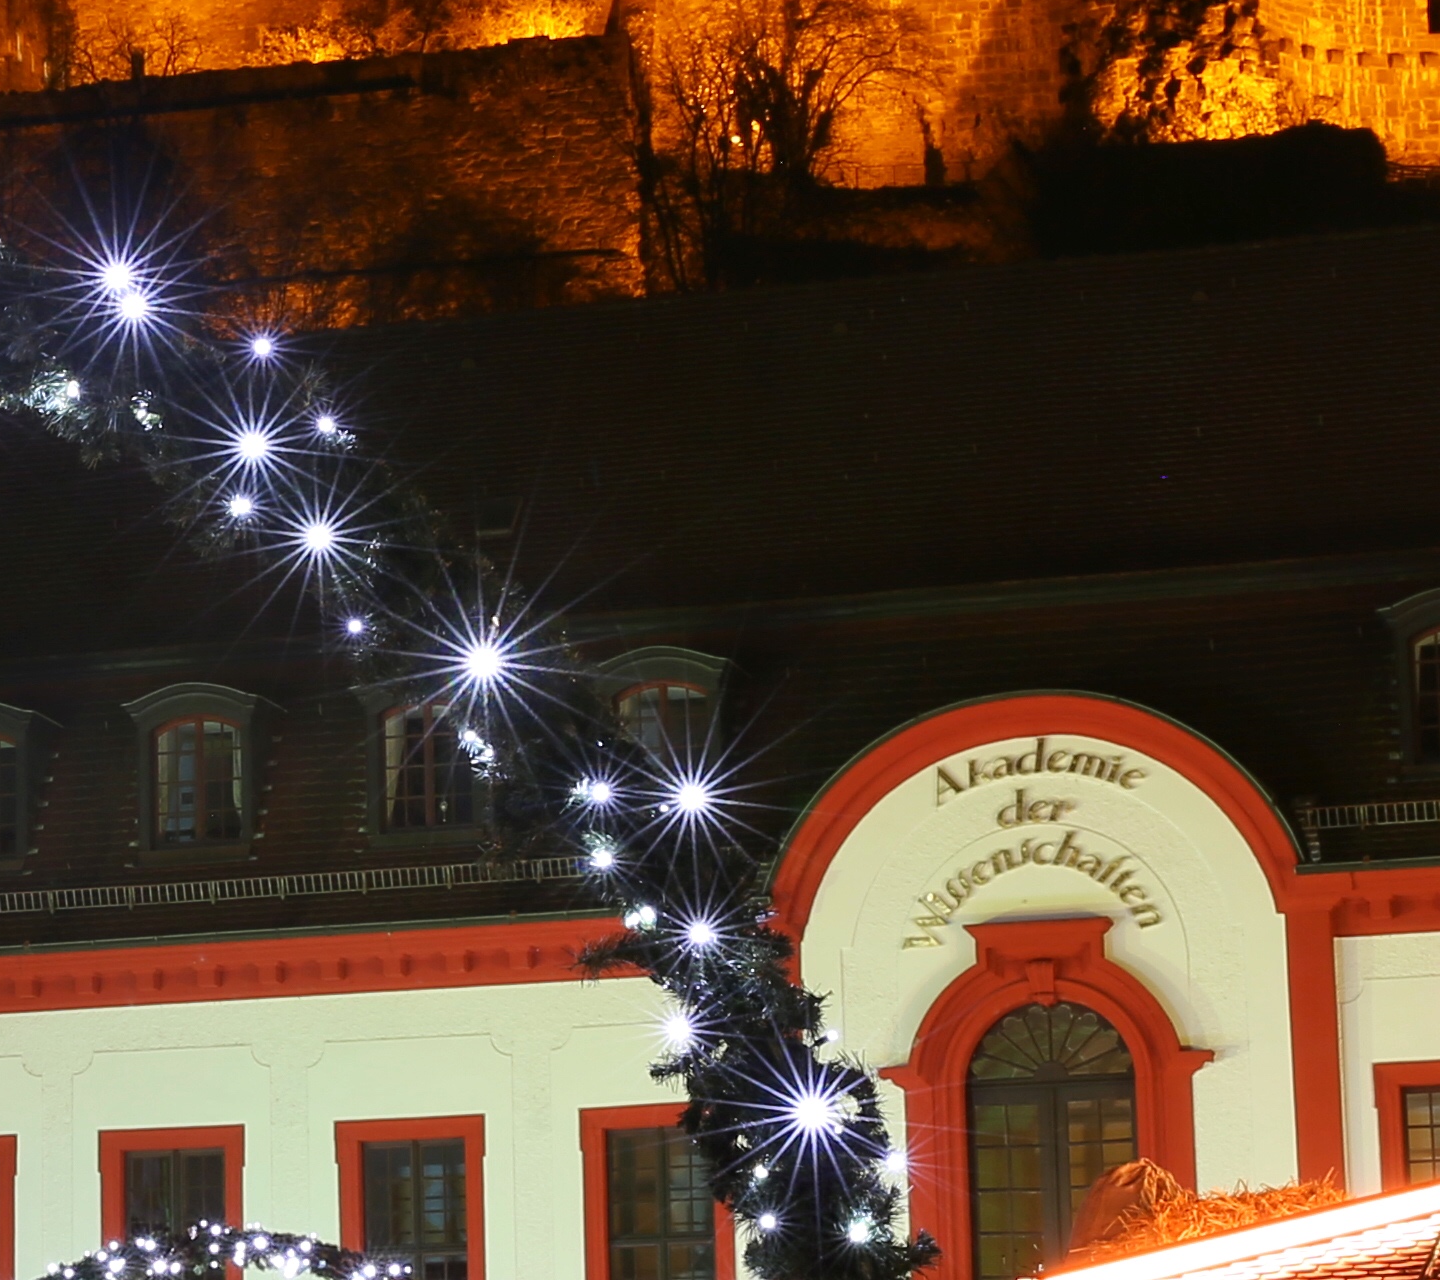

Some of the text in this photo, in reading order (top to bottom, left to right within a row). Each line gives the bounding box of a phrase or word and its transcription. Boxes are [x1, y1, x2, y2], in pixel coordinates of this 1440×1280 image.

[934, 737, 1147, 807] Akademie
[996, 788, 1074, 829] der
[901, 830, 1161, 950] Wissenschaften
